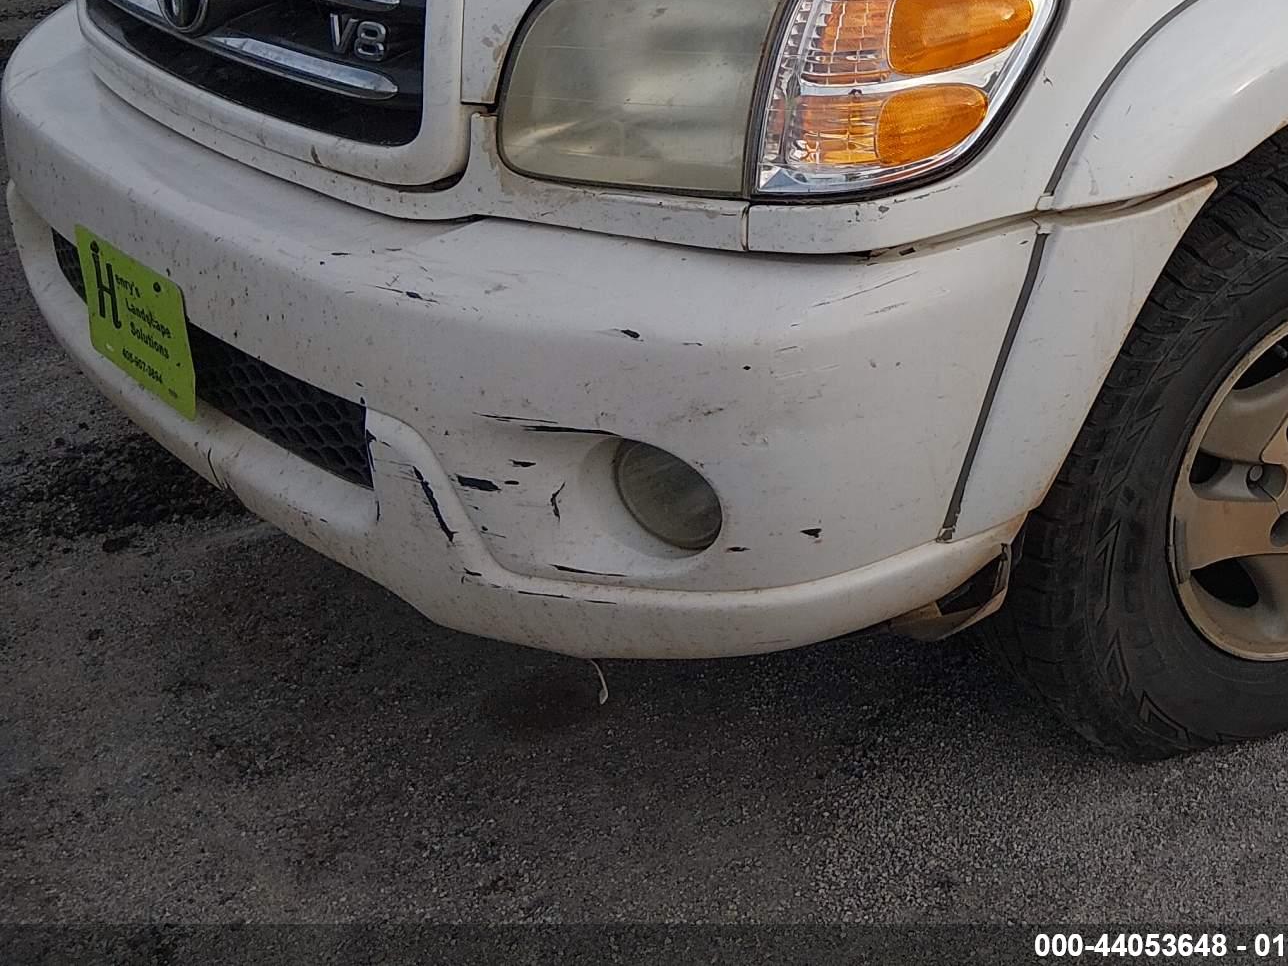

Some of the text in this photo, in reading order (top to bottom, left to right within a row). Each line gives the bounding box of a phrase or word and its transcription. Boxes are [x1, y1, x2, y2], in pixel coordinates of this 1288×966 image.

[329, 12, 387, 62] V8
[124, 297, 172, 339] Landscape
[130, 321, 170, 360] Solutions
